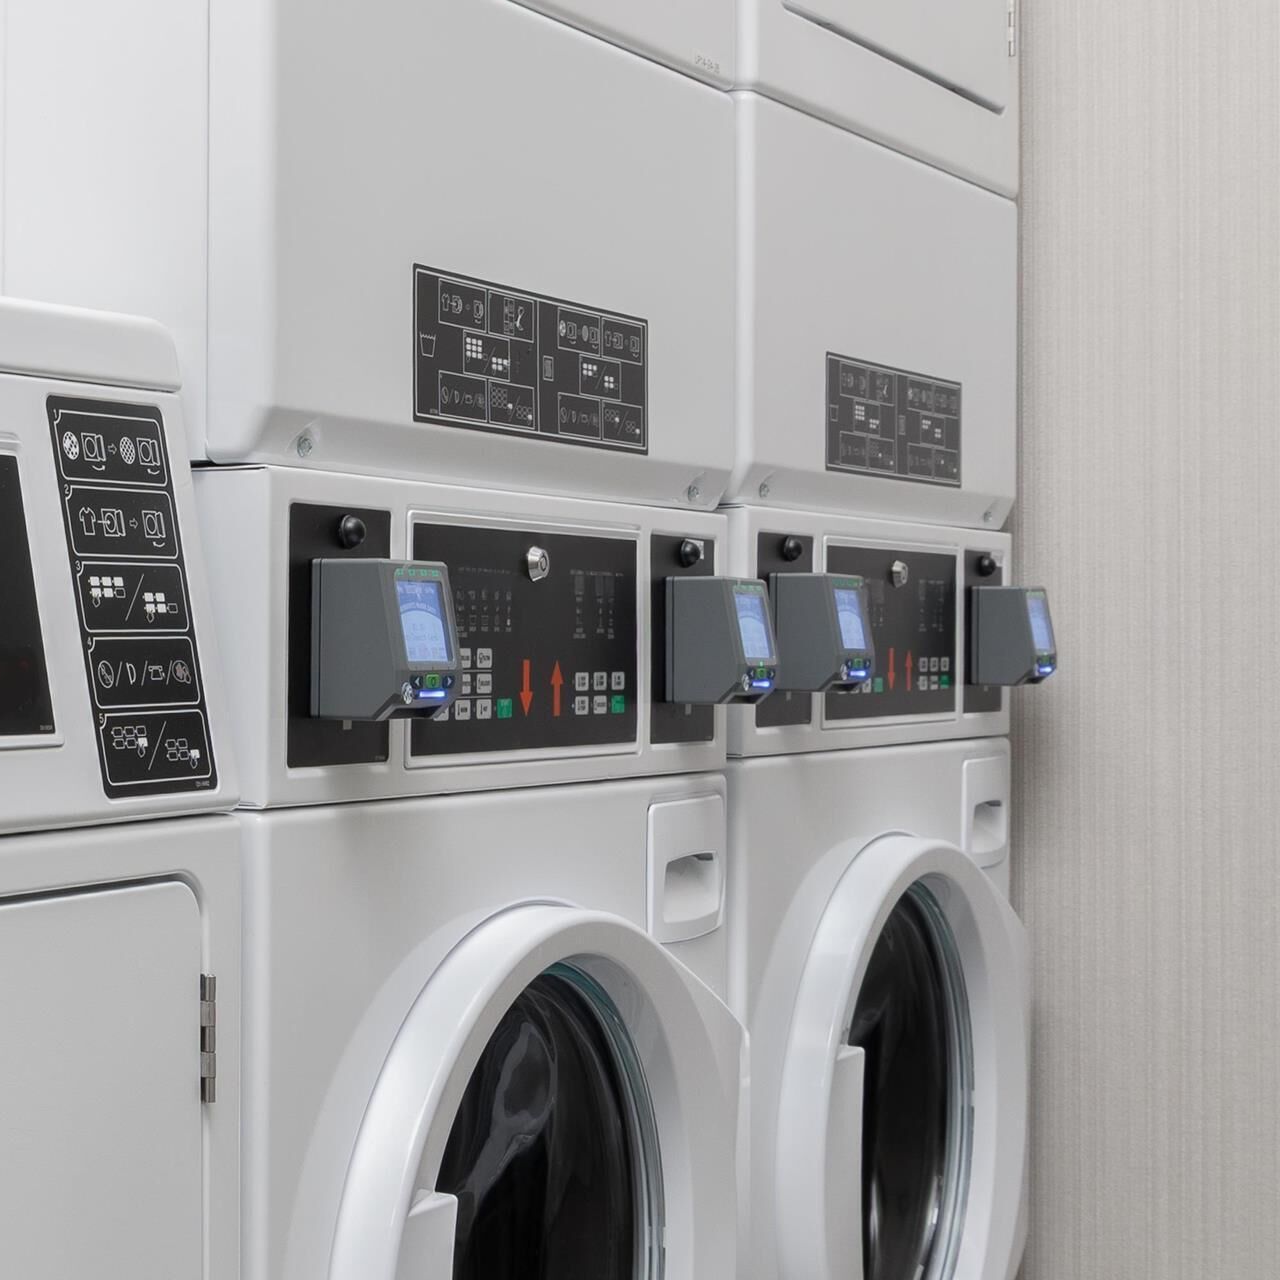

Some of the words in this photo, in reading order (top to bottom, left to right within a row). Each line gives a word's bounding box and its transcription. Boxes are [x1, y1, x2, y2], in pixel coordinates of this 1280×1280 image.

[64, 483, 69, 494] 2
[75, 560, 81, 571] 3
[98, 713, 105, 724] 5
